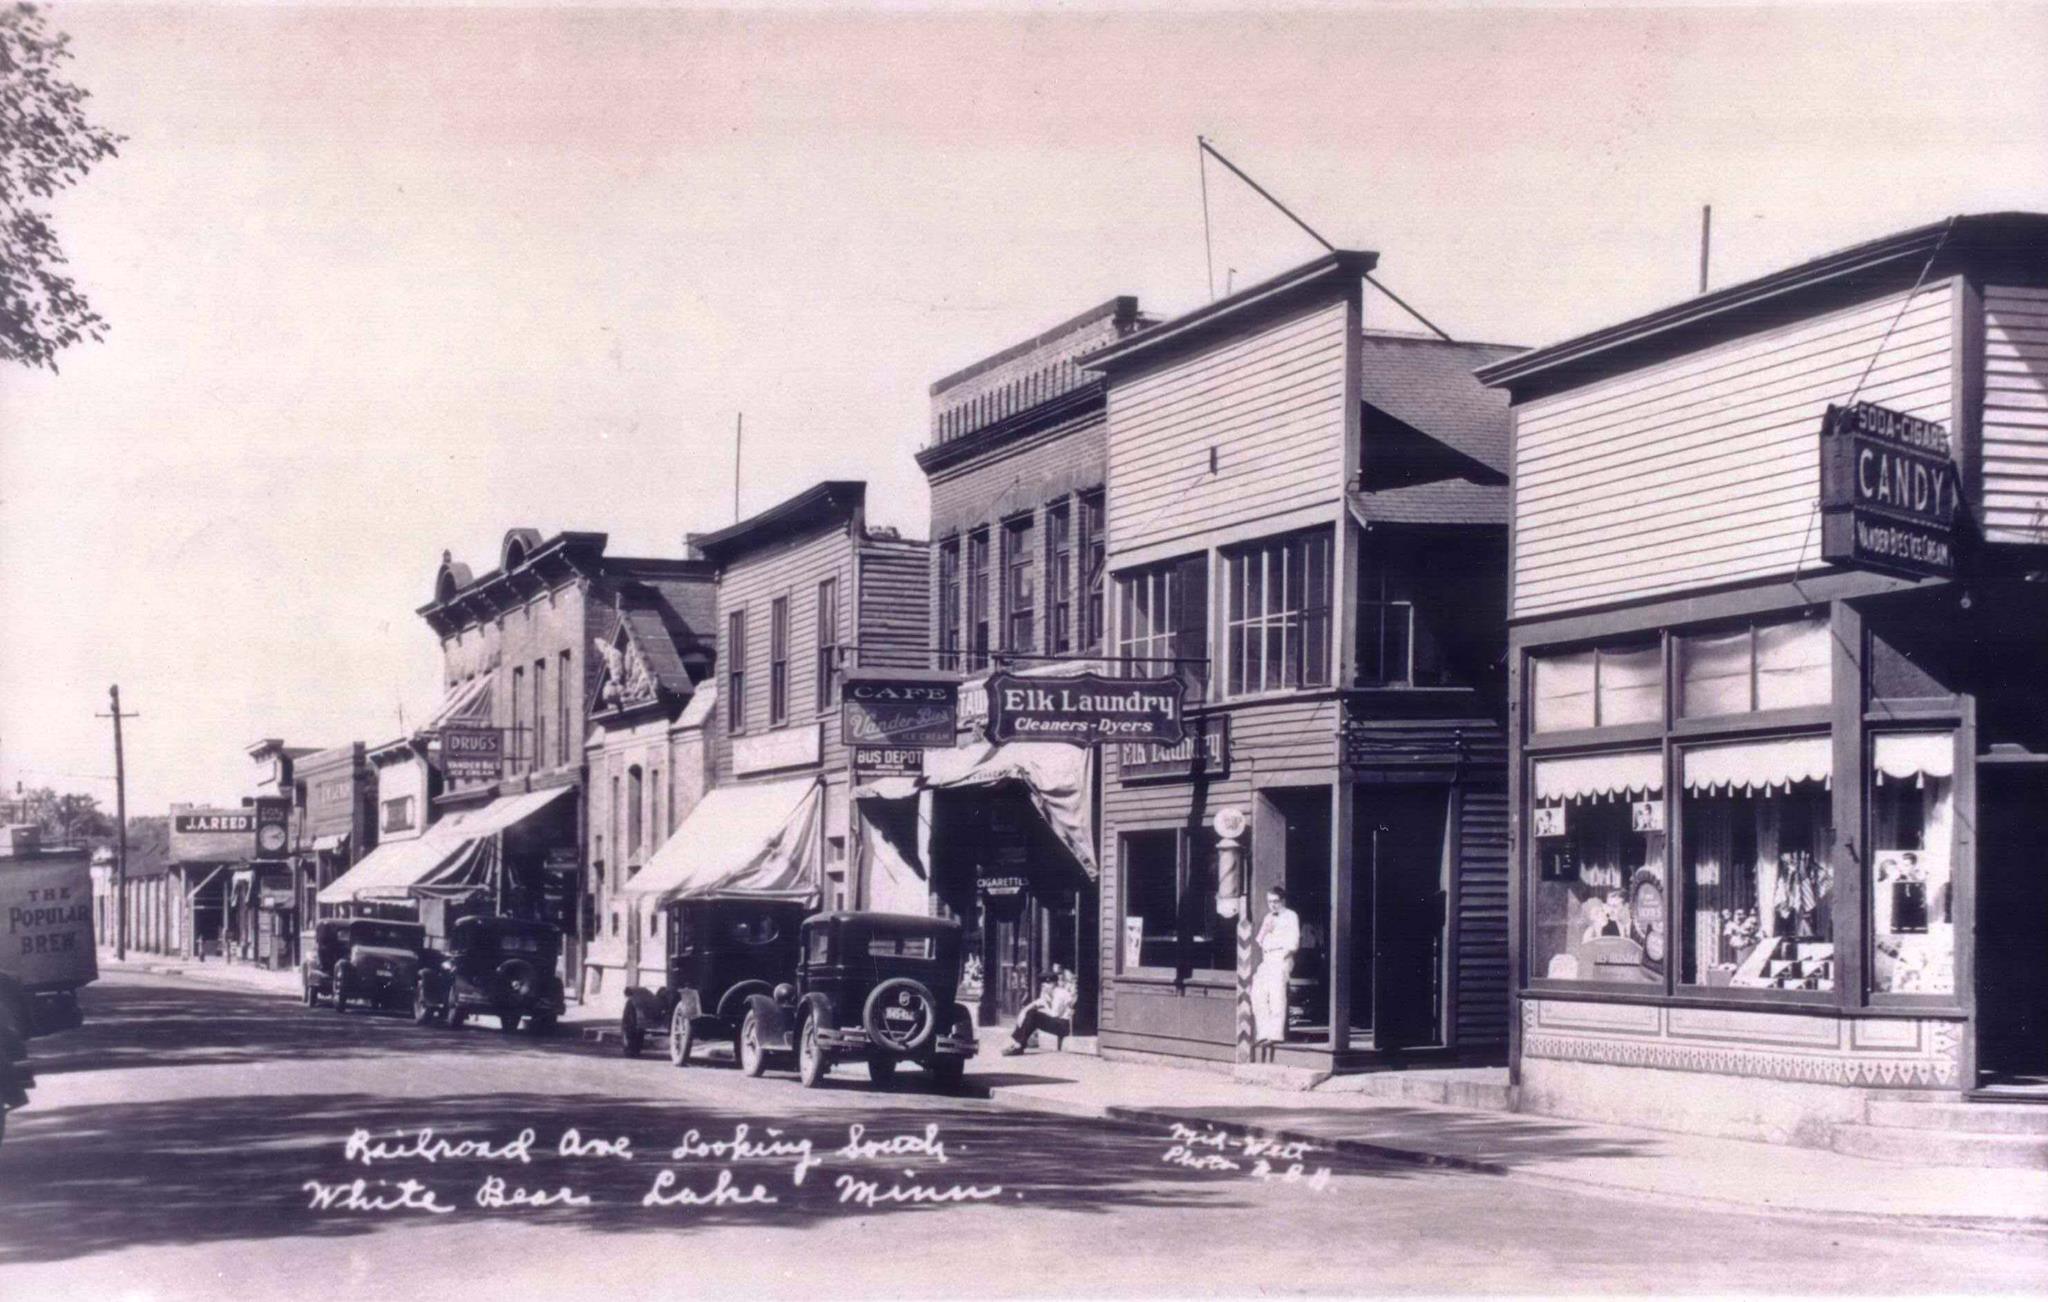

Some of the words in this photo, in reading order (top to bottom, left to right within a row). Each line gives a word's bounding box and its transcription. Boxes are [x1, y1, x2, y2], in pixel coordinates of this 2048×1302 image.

[1859, 448, 1944, 516] CANDY
[854, 687, 947, 700] CAFE
[1005, 689, 1055, 711] Elk
[1061, 690, 1174, 720] Laundry
[451, 735, 496, 750] DRUGS
[857, 750, 882, 764] BUS
[884, 750, 922, 765] DEPOT
[28, 887, 71, 901] THE
[8, 905, 88, 934] POPULAR
